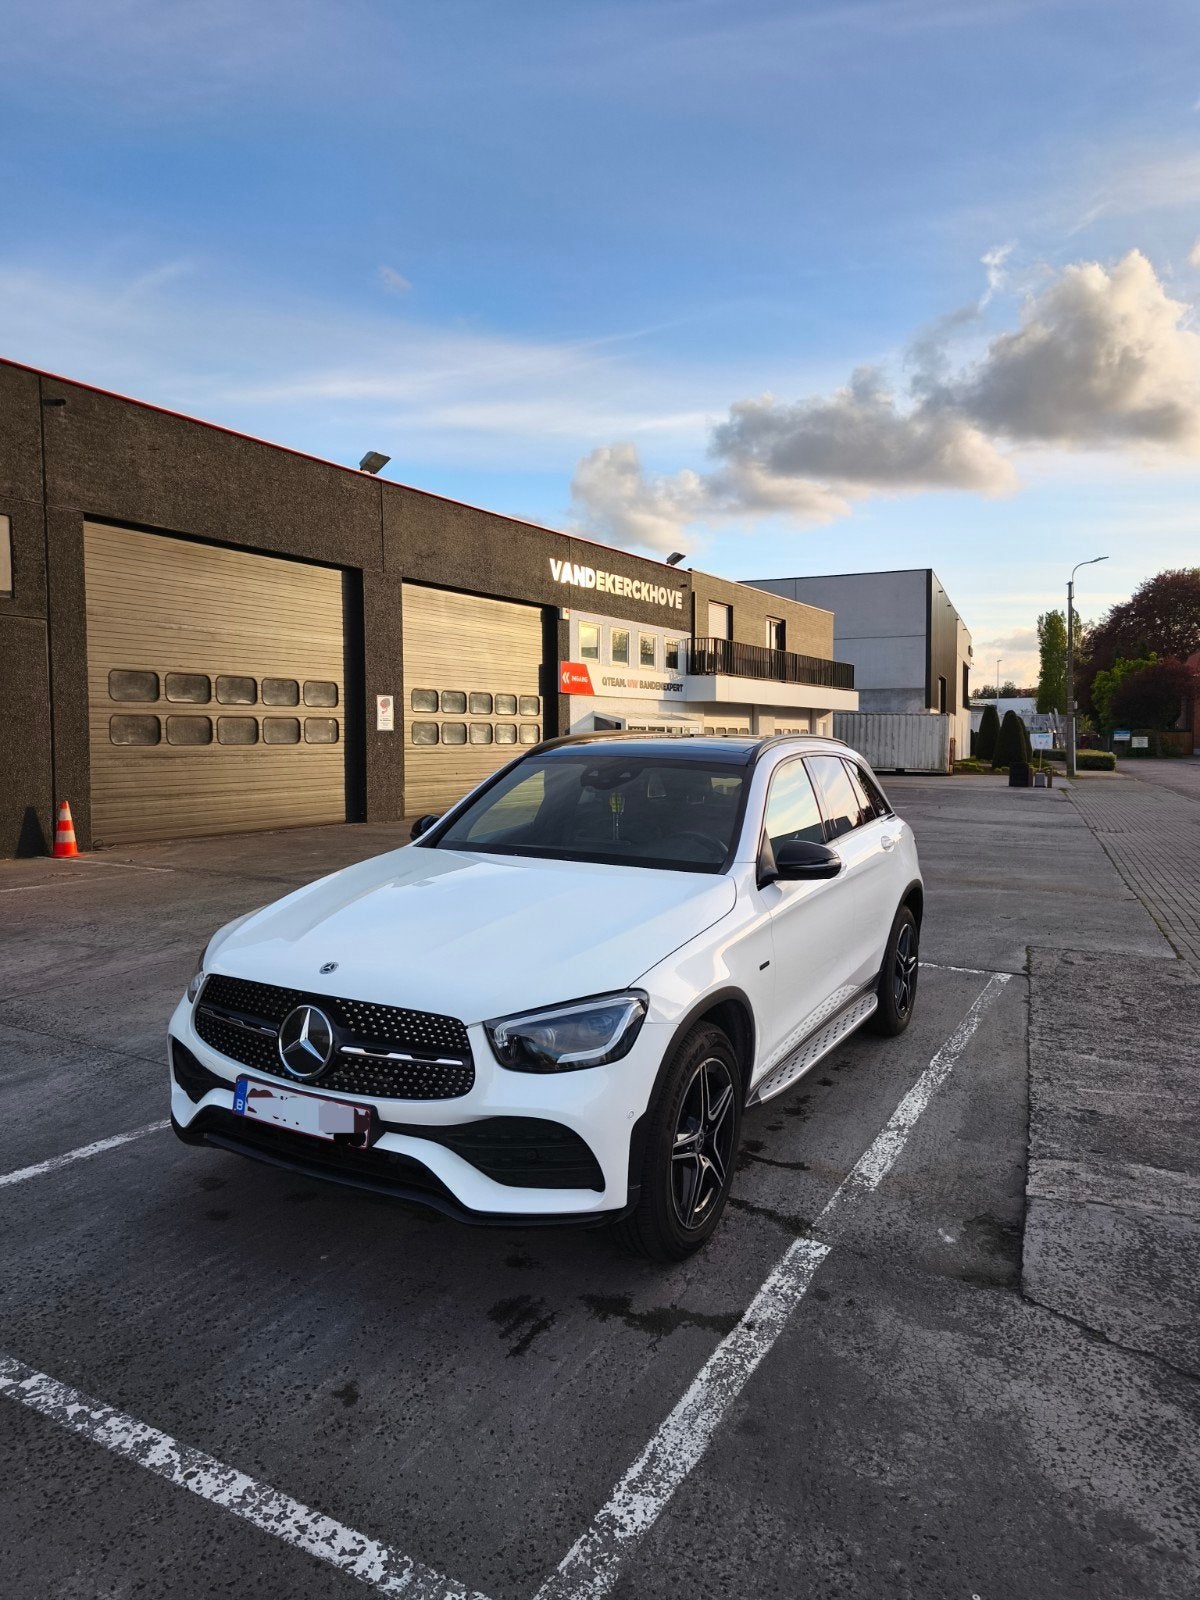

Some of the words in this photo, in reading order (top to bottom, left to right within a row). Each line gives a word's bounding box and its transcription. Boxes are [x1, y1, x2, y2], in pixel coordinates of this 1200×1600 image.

[549, 558, 683, 609] VANDEKERCKHOVE
[628, 679, 639, 689] UW
[639, 680, 684, 692] BANDENEXPERT
[236, 1098, 243, 1111] B
